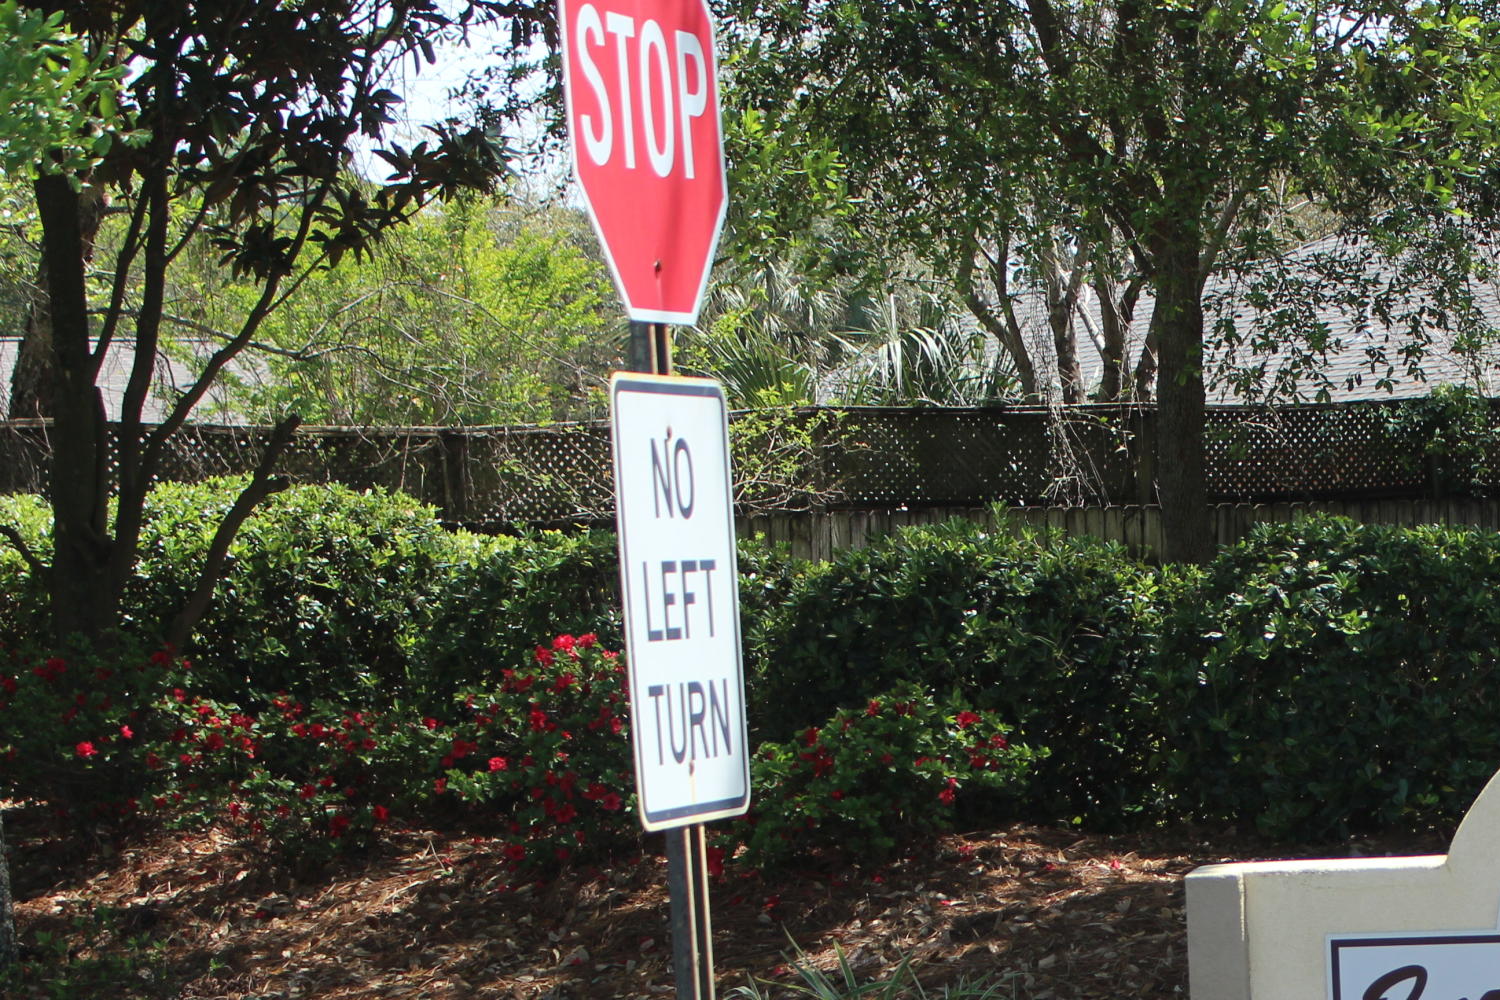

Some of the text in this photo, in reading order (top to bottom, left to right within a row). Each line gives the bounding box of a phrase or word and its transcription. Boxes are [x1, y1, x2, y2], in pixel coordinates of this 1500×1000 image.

[577, 4, 707, 179] STOP
[651, 438, 695, 520] NO
[643, 560, 717, 642] LEFT
[648, 679, 732, 766] TURN
